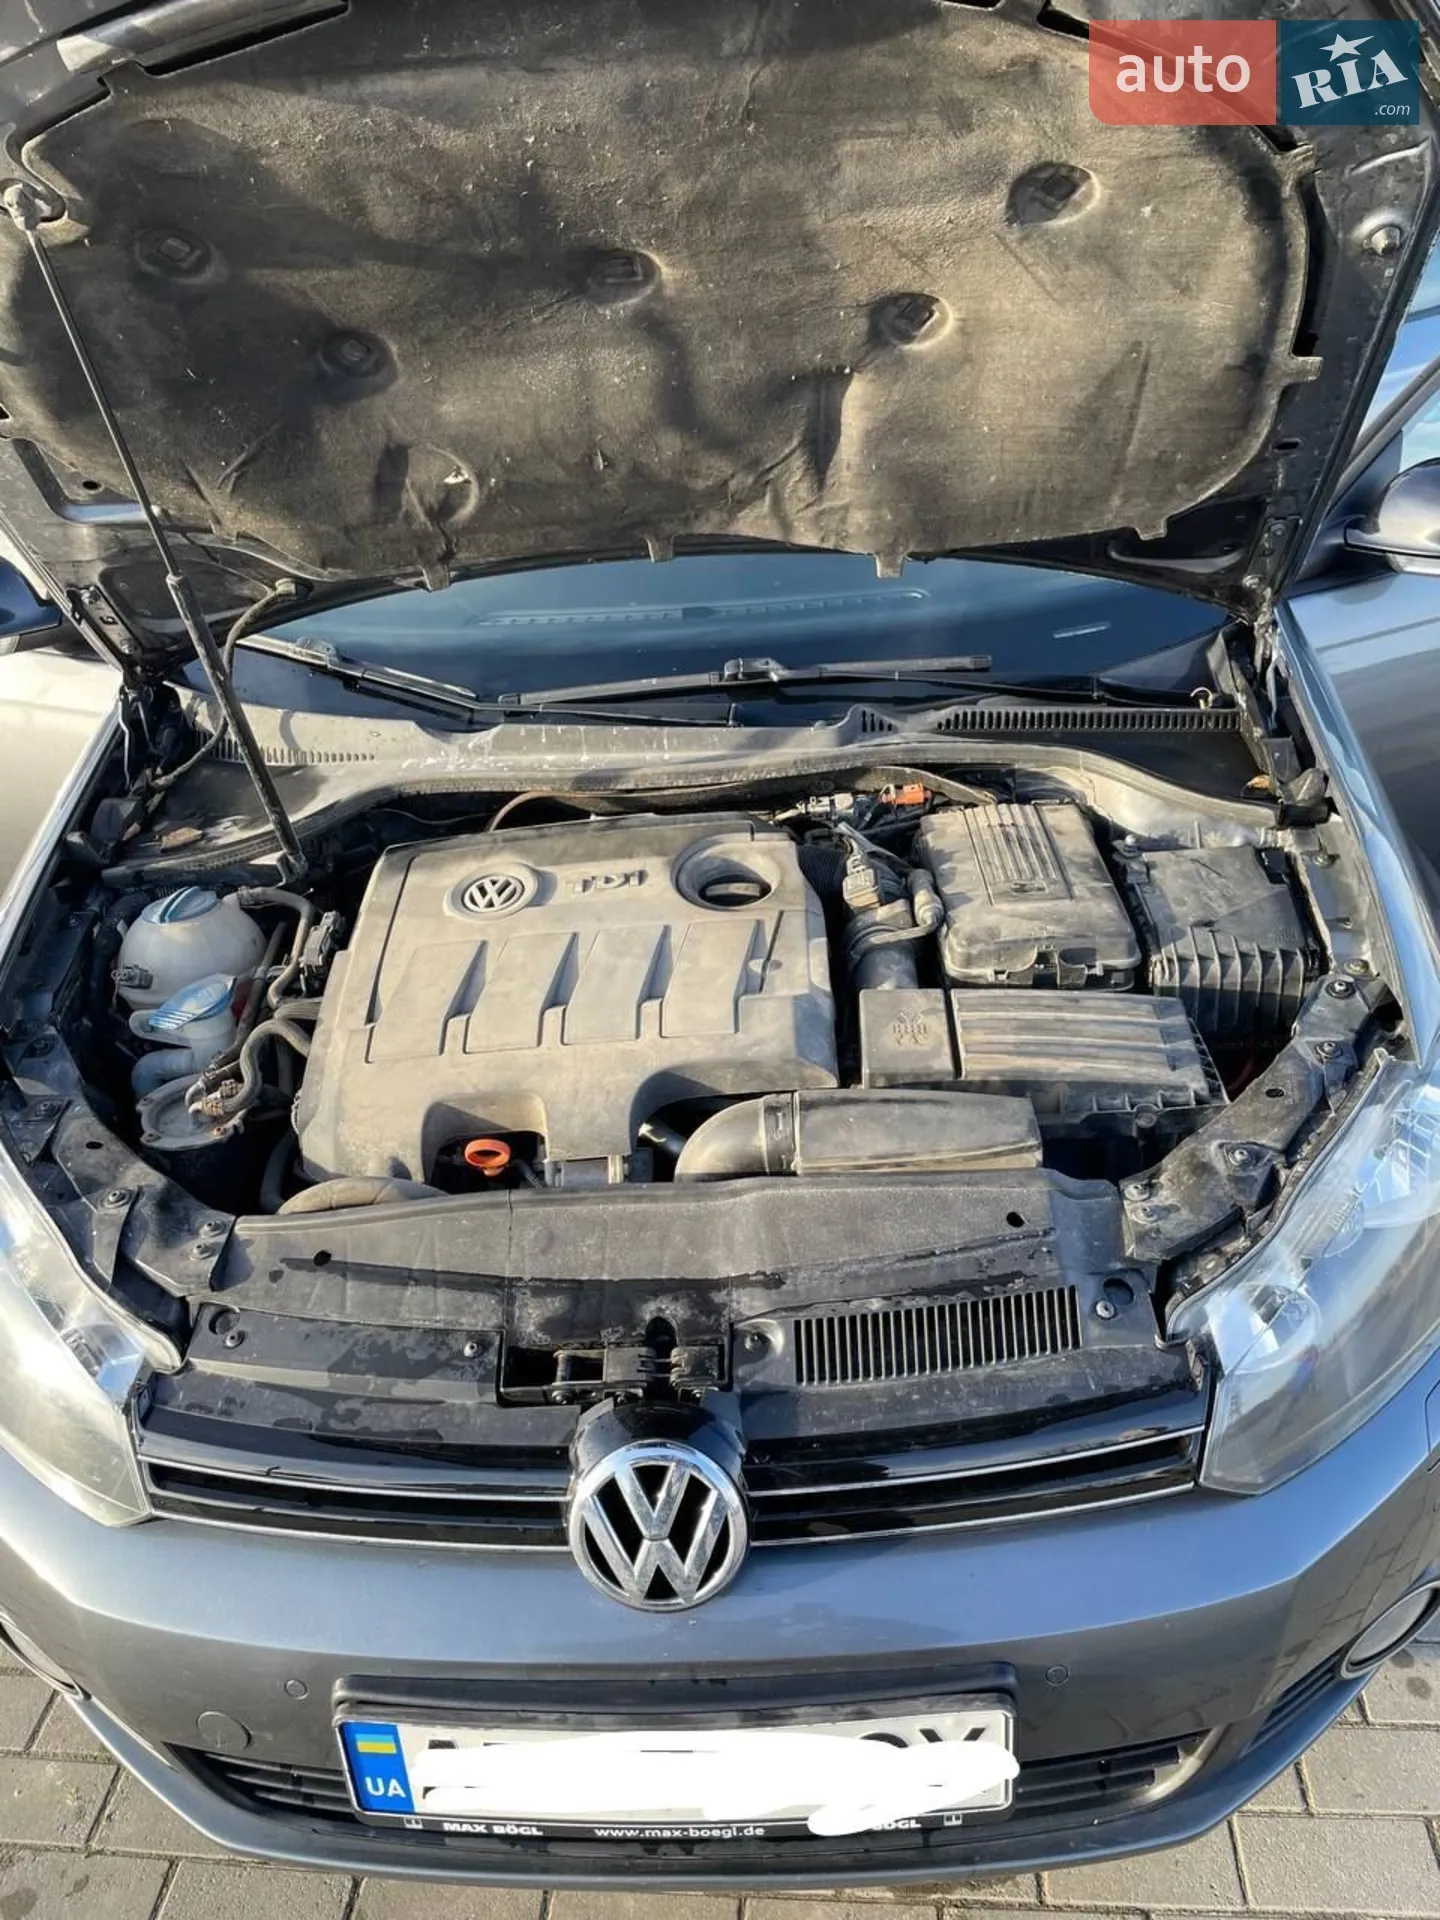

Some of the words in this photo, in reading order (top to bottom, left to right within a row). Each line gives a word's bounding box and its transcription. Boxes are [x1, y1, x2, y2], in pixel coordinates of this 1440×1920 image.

[565, 869, 648, 892] TDI
[365, 1777, 406, 1798] UA
[443, 1821, 488, 1833] MAX
[594, 1826, 765, 1839] www.max-boegl.de
